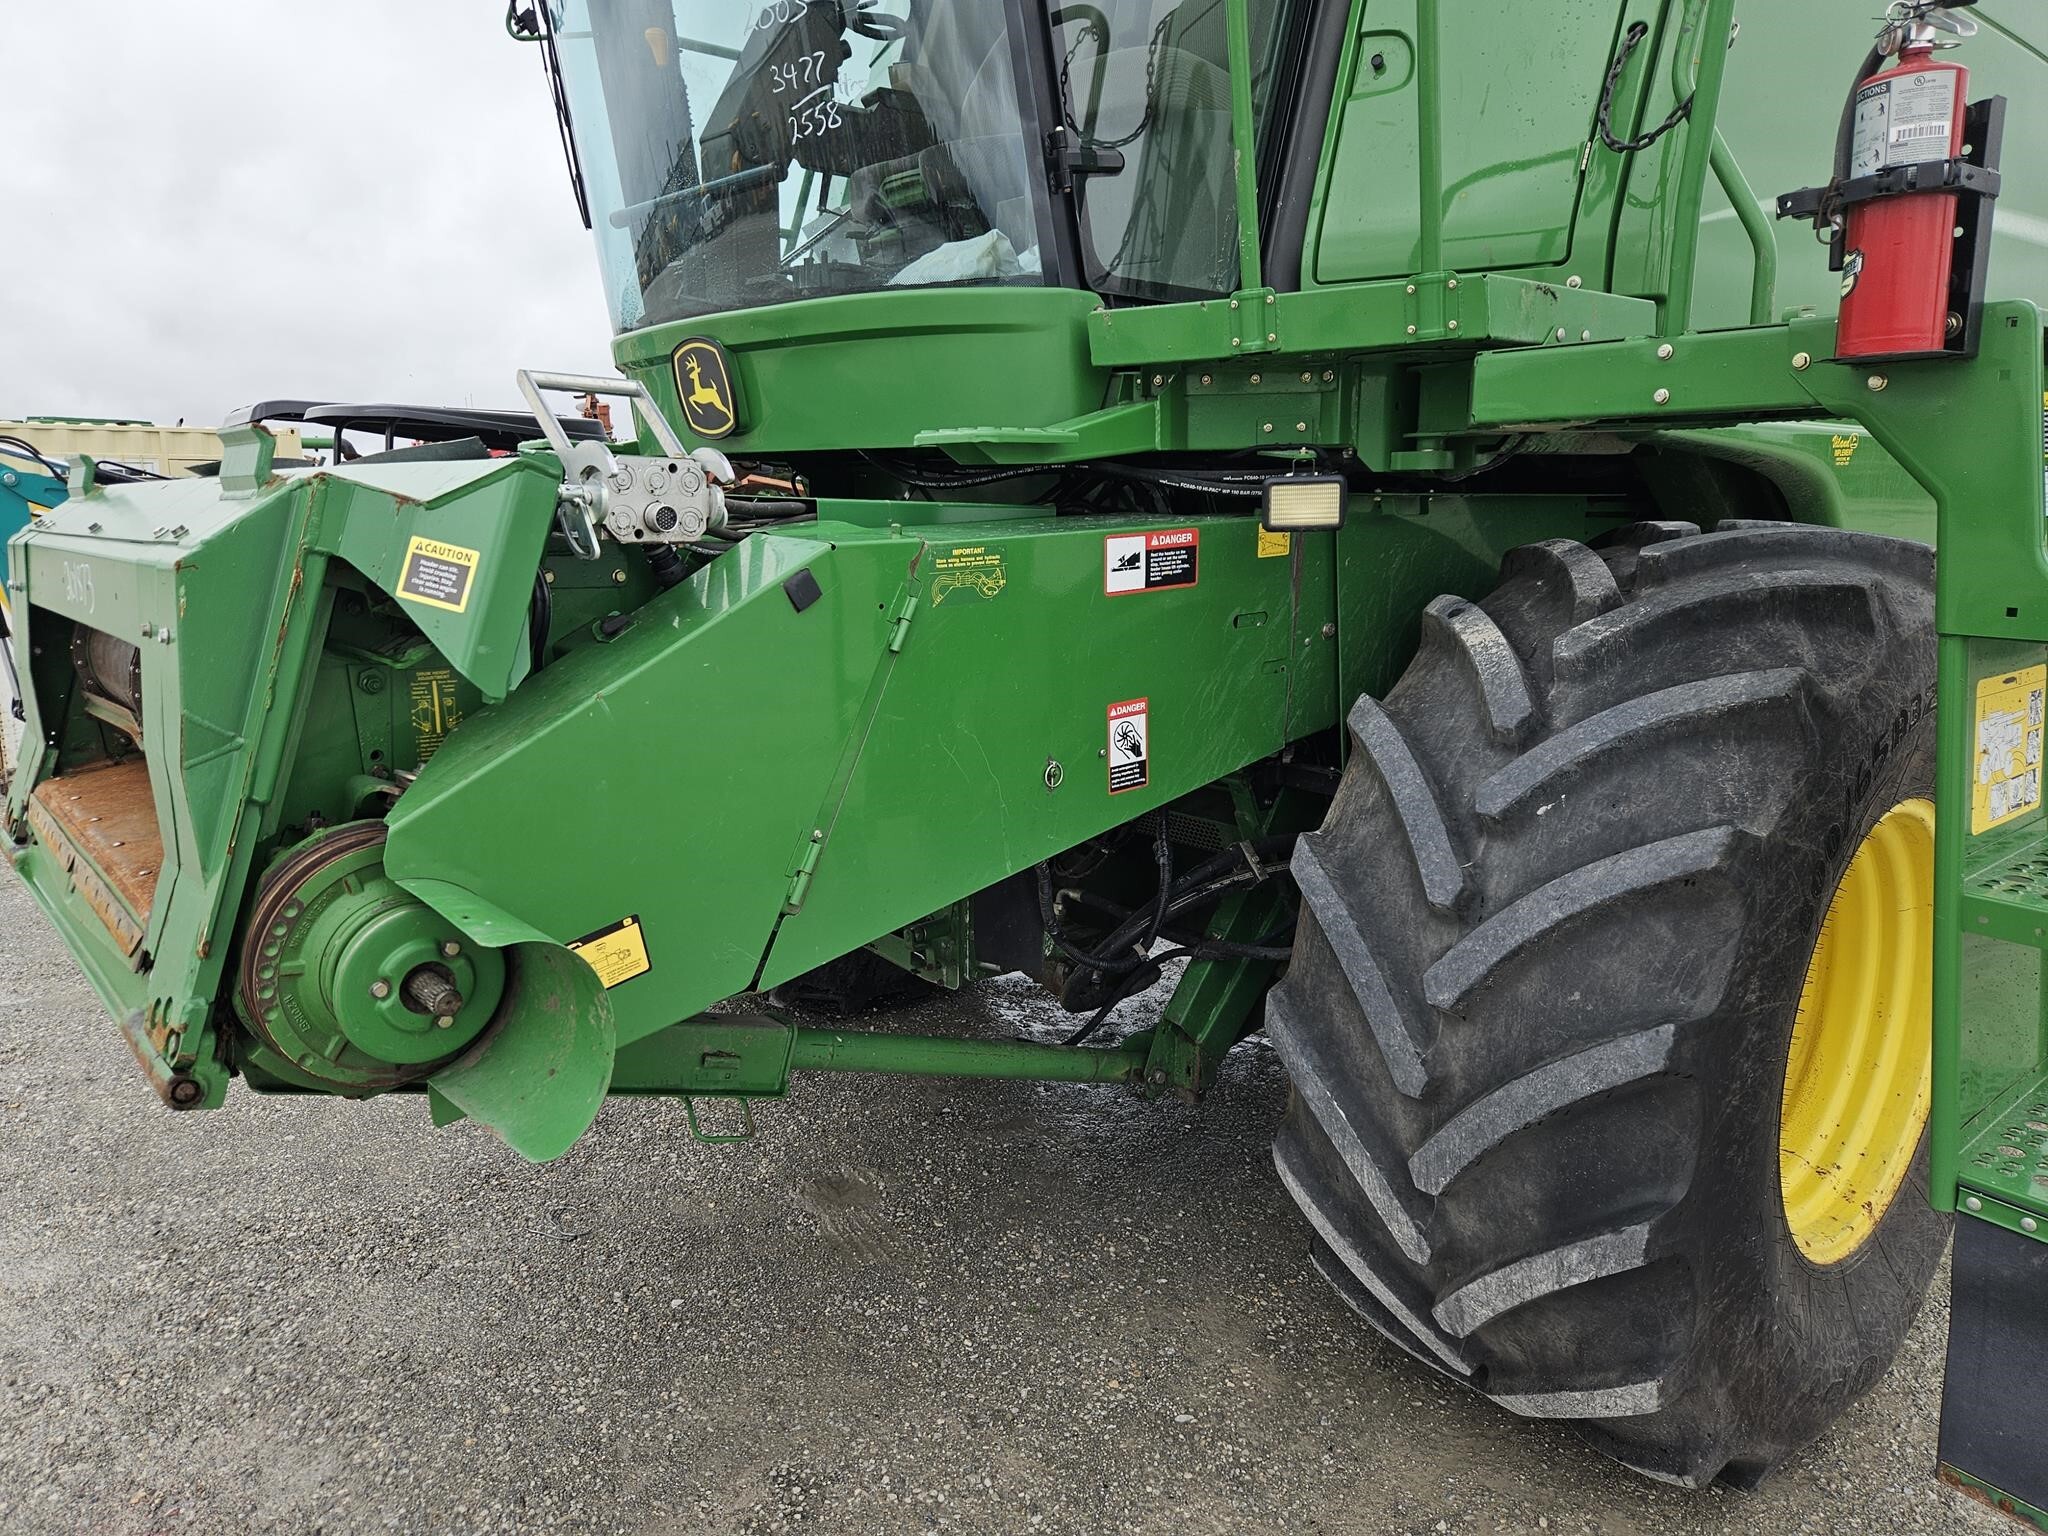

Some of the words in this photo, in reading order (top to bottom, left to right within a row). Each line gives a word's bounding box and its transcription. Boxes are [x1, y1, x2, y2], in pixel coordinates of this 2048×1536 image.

[770, 51, 825, 93] 3477
[788, 100, 842, 146] 2558
[1160, 533, 1192, 545] DANGER
[424, 543, 472, 562] CAUTION
[952, 547, 985, 556] IMPORTANT
[1116, 702, 1146, 715] DANGER
